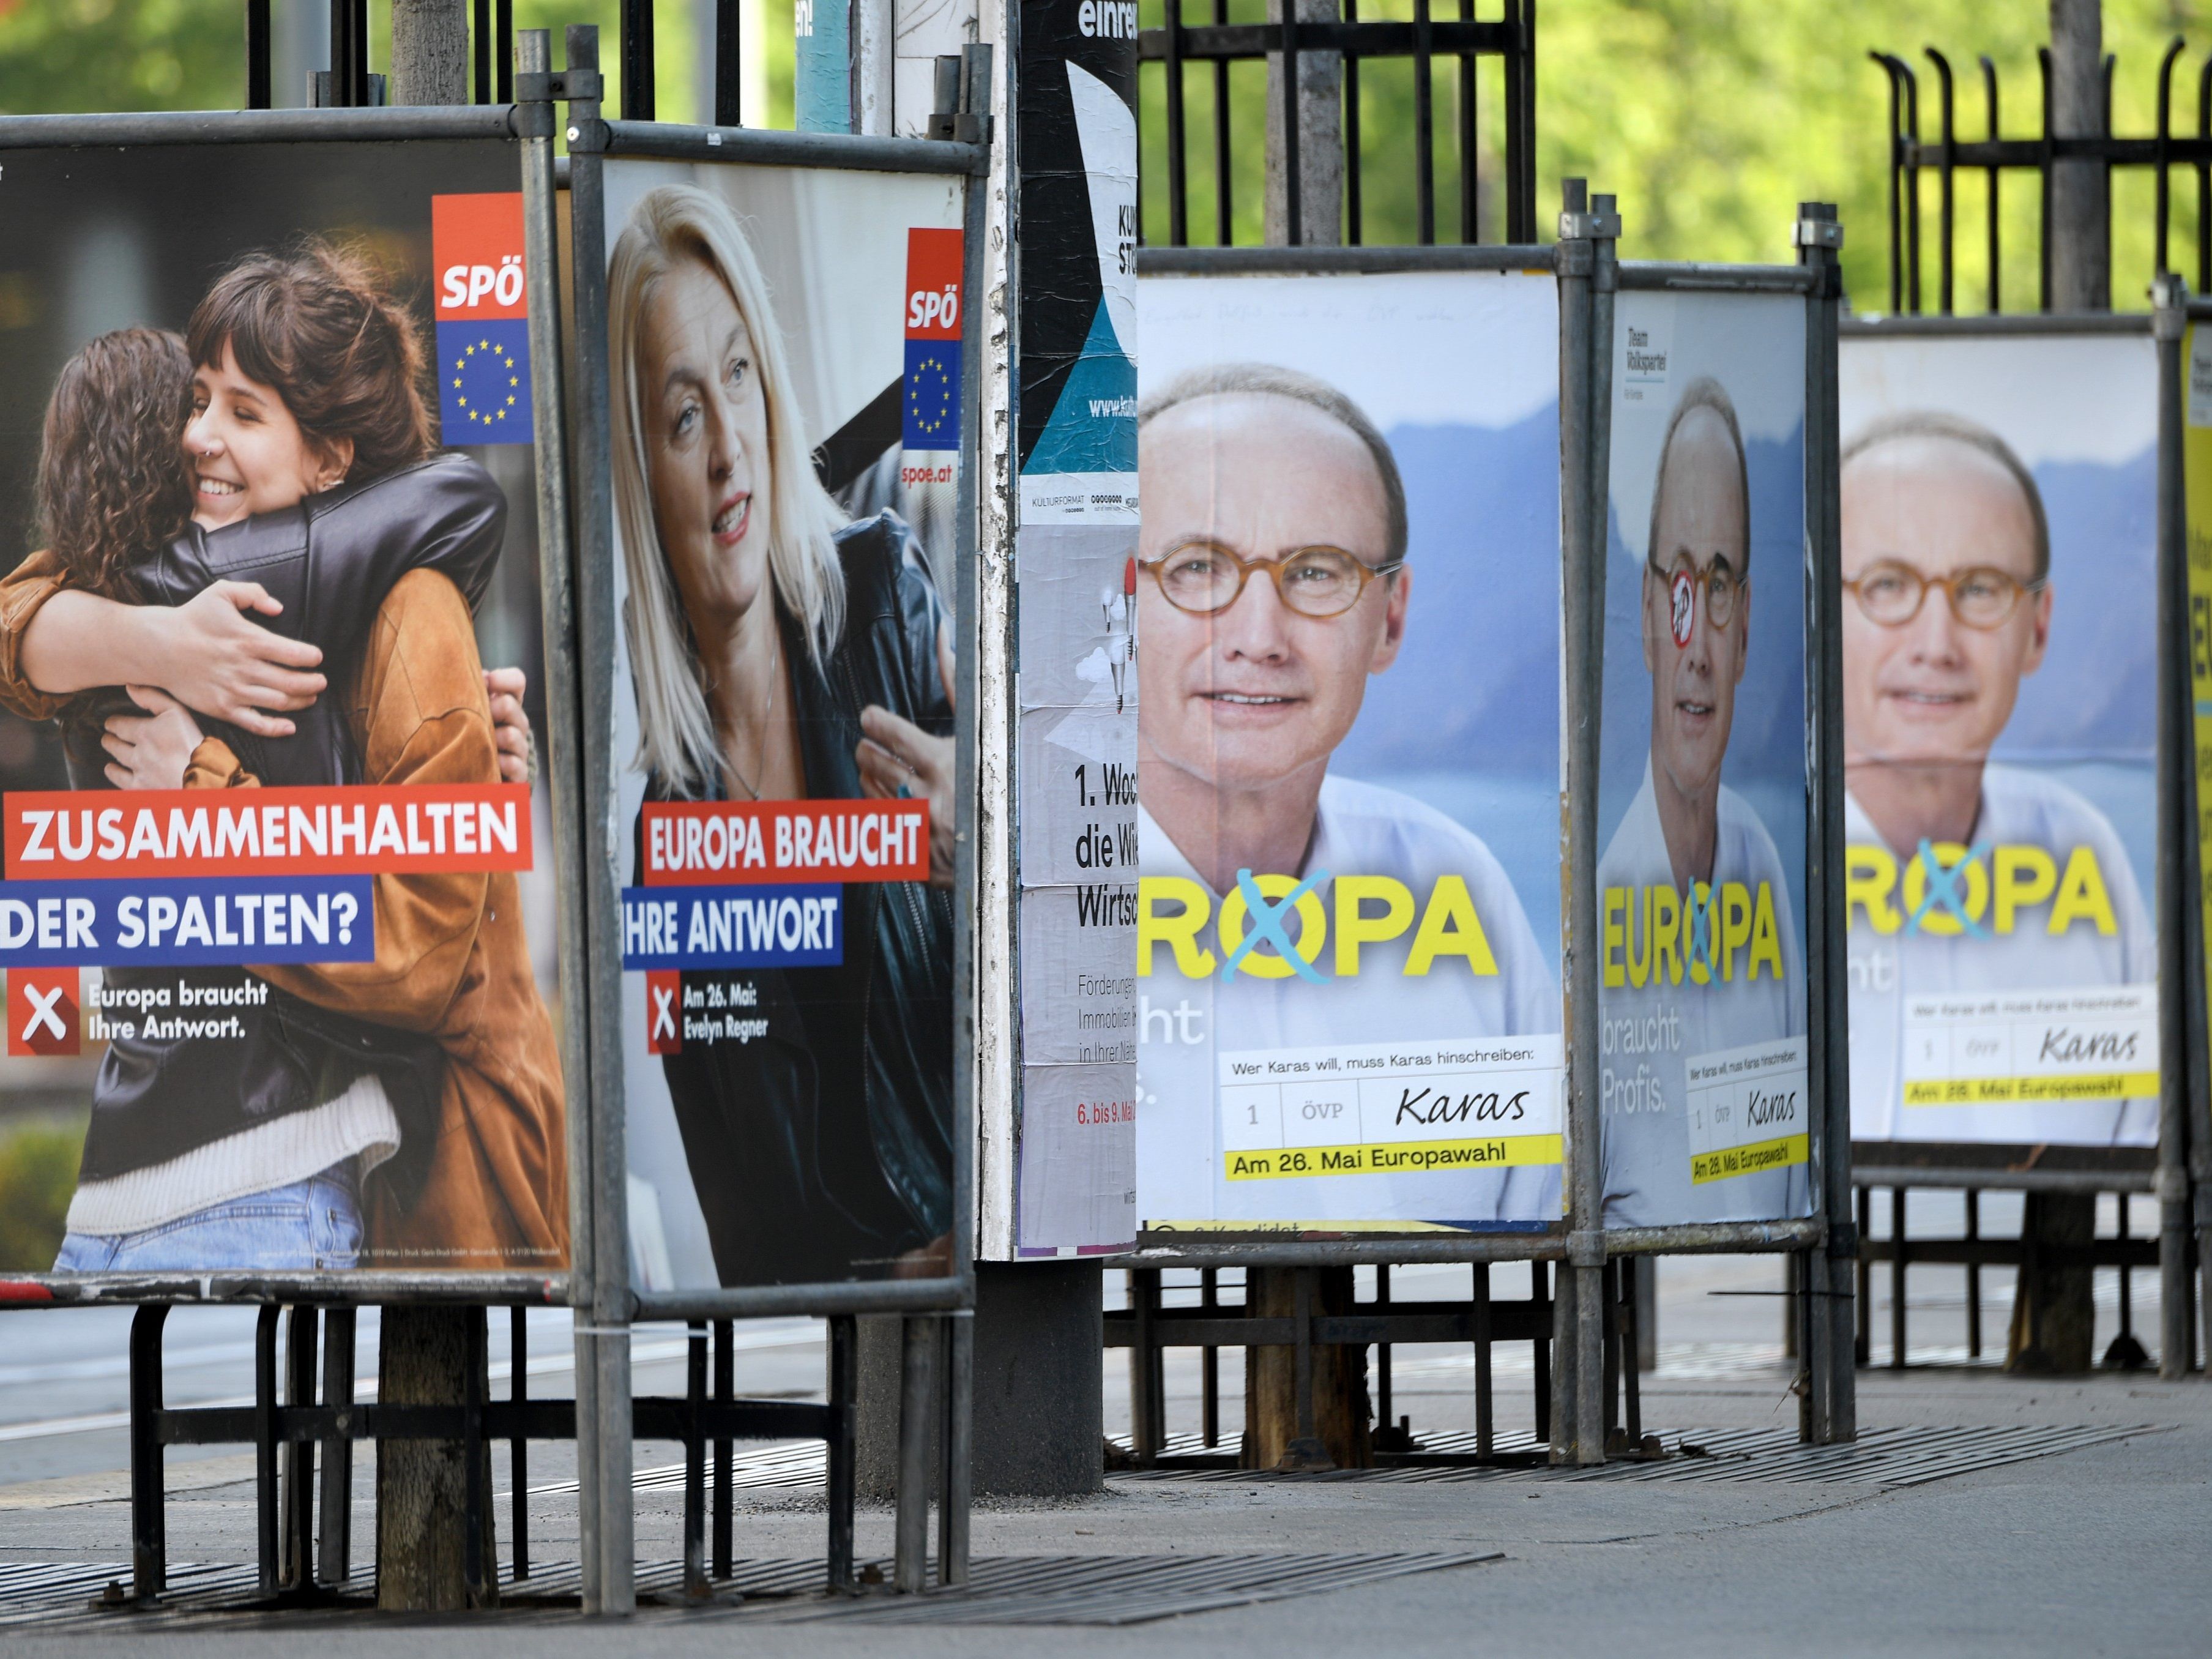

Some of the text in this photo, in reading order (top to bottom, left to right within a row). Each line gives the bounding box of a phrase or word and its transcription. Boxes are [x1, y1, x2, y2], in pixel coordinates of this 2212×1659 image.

[441, 255, 524, 308] SPÖ
[907, 284, 958, 329] SPÖ
[902, 464, 952, 489] spoe.at
[1032, 496, 1084, 507] KULTURFORMAT
[1075, 762, 1138, 806] 1. Woc
[20, 802, 517, 862] ZUSAMMENHALTEN
[650, 813, 922, 870] EUROPA BRAUCHT
[1076, 824, 1112, 868] die
[0, 892, 359, 949] DER SPALTEN?
[688, 897, 837, 953] ANTWORT
[1604, 880, 1784, 989] EUROPA
[88, 980, 268, 1012] Europa braucht
[683, 982, 757, 1008] Am 26. Mai:
[89, 1014, 245, 1040] Ihre Antwort.
[684, 1018, 769, 1045] Evelyn Regner
[1603, 1003, 1680, 1056] braucht
[2039, 1027, 2140, 1063] Karas
[1079, 1042, 1090, 1062] in
[1095, 1042, 1119, 1062] Ihrer
[1232, 1048, 1533, 1075] Wer Karas will, muss Karas hinschreiben:
[1248, 1087, 1530, 1125] 1 ÖVP Karas
[1602, 1062, 1666, 1115] Profis.
[1078, 1103, 1089, 1124] 6.
[1093, 1102, 1109, 1124] bis
[1112, 1102, 1120, 1122] 9.
[1748, 1090, 1796, 1128] Karas
[1234, 1143, 1505, 1174] Am 26. Mai Europawahl
[1694, 1161, 1707, 1179] Am
[1740, 1142, 1788, 1170] Europawahl
